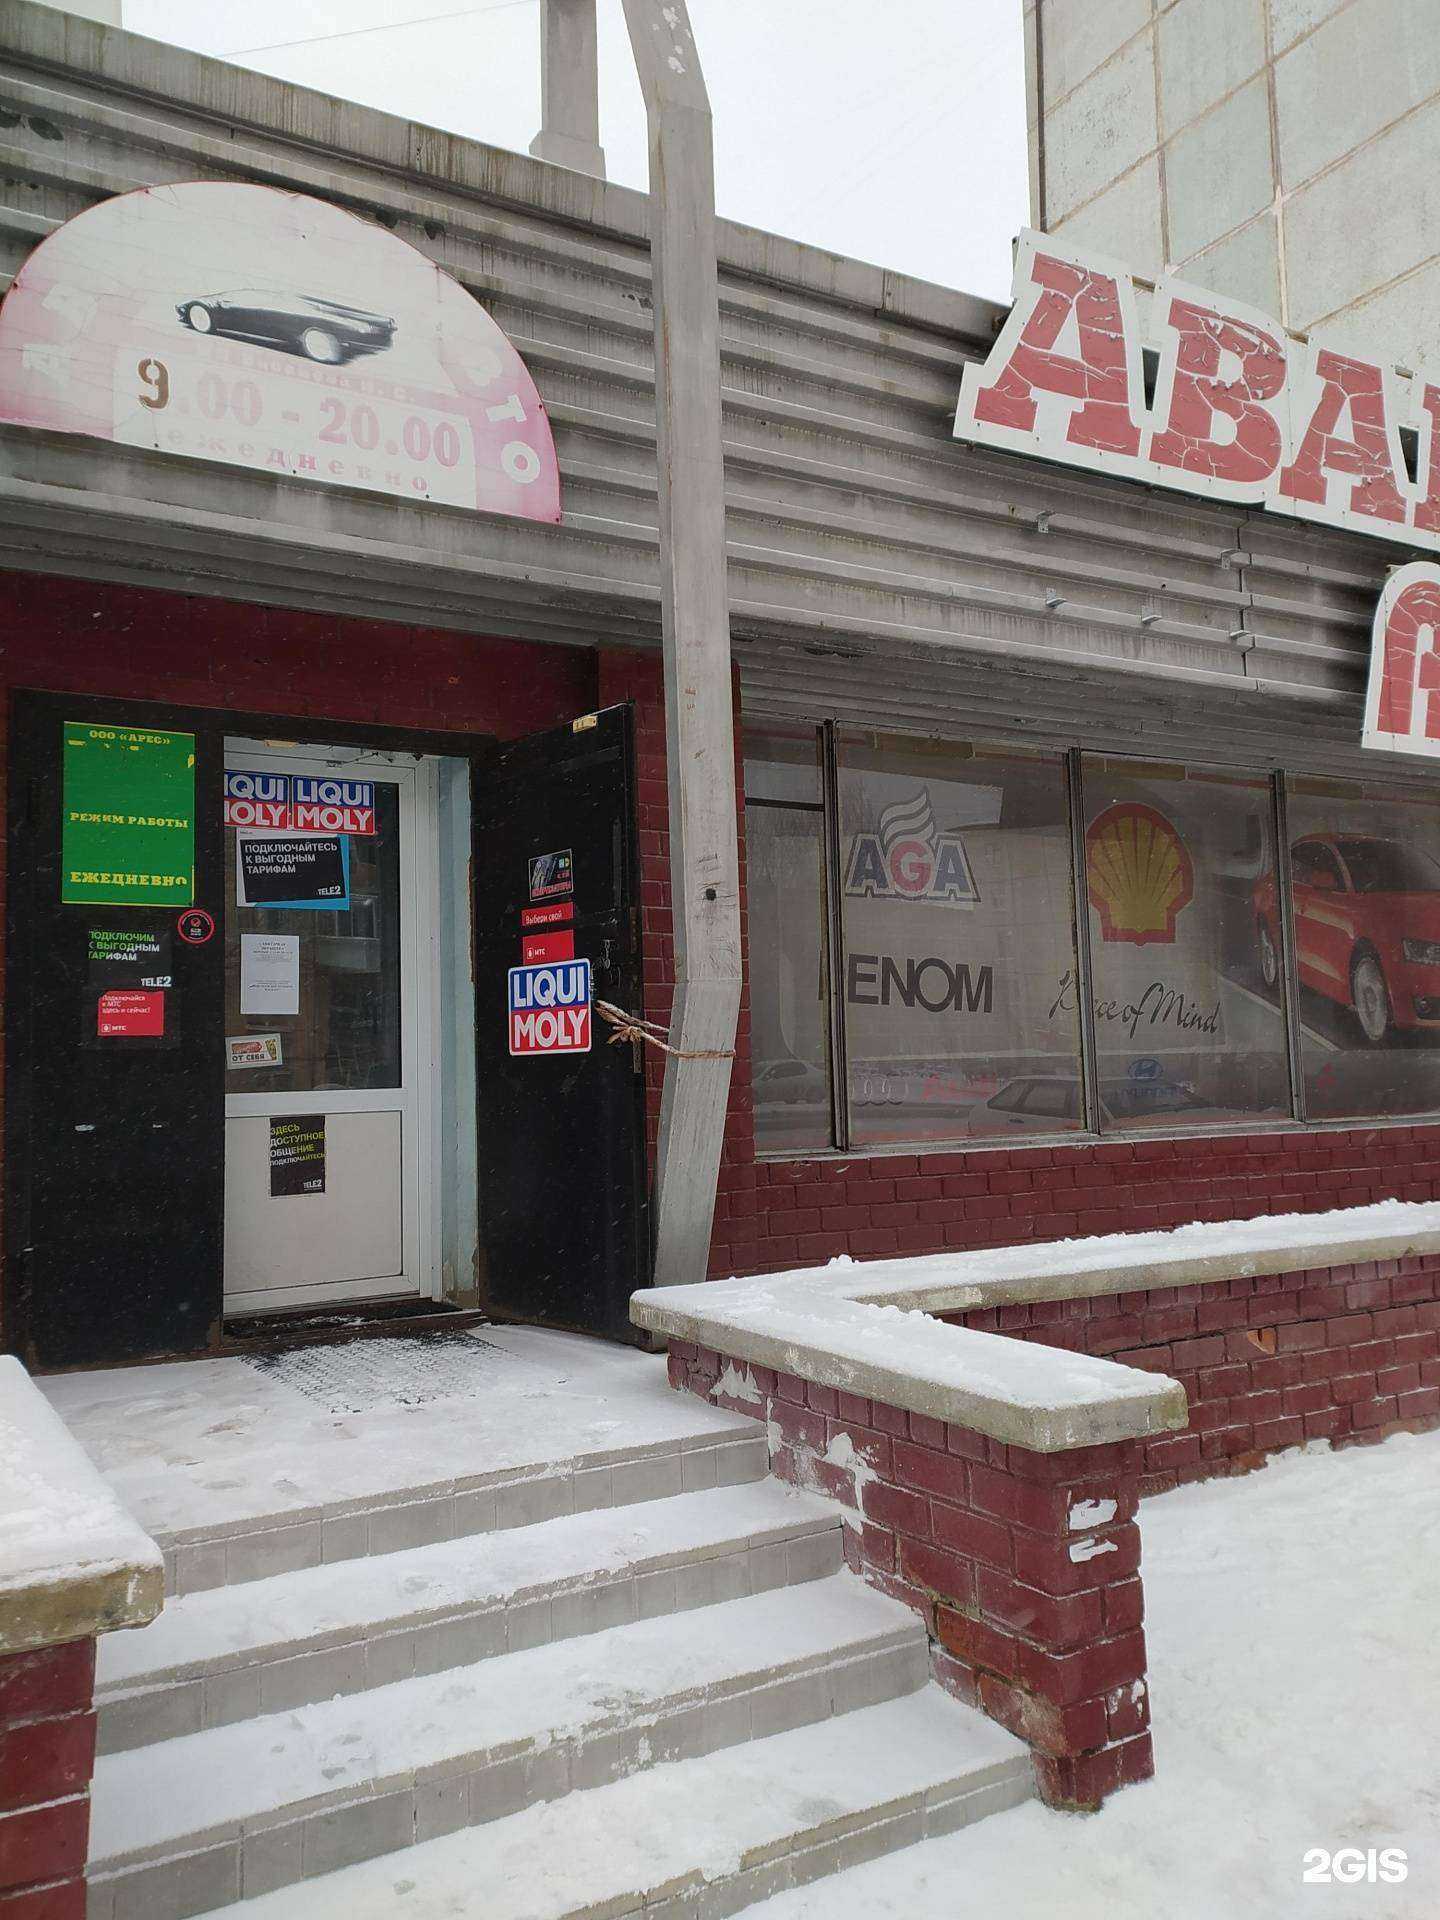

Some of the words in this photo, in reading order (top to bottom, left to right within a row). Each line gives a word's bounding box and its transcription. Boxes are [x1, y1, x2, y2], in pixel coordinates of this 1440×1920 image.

[974, 252, 1440, 531] АВА
[320, 397, 461, 467] 20.00
[167, 427, 428, 491] ежедневно
[89, 730, 116, 741] ООО
[119, 733, 170, 745] «АРЕС»
[297, 779, 370, 806] LIQUI
[70, 812, 124, 824] РЕЖИМ
[128, 815, 189, 828] РАБОТЫ
[297, 805, 372, 831] MOLY
[245, 841, 338, 854] ПОДКЛЮЧАЙТЕСЬ
[245, 855, 253, 864] К
[255, 854, 316, 865] ВЫГОДНЫМ
[846, 834, 981, 901] AGA
[247, 864, 297, 875] ТАРИФАМ
[70, 871, 188, 887] ЕЖЕДНЕВНО
[317, 885, 342, 896] TELE2
[526, 913, 548, 925] Выбери
[548, 910, 563, 921] свой
[97, 942, 160, 953] ВЫГОДНЫМ
[140, 975, 172, 988] TELE2
[514, 966, 585, 1008] LIQUI
[820, 950, 993, 1013] ENOM
[1149, 982, 1222, 1034] Mind
[111, 1024, 128, 1032] МТС
[514, 1009, 588, 1049] MOLY
[270, 1124, 300, 1136] ЗДЕСЬ
[270, 1131, 325, 1147] ДОСТУПНОЕ
[269, 1144, 315, 1158] ОБЩЕНИЕ
